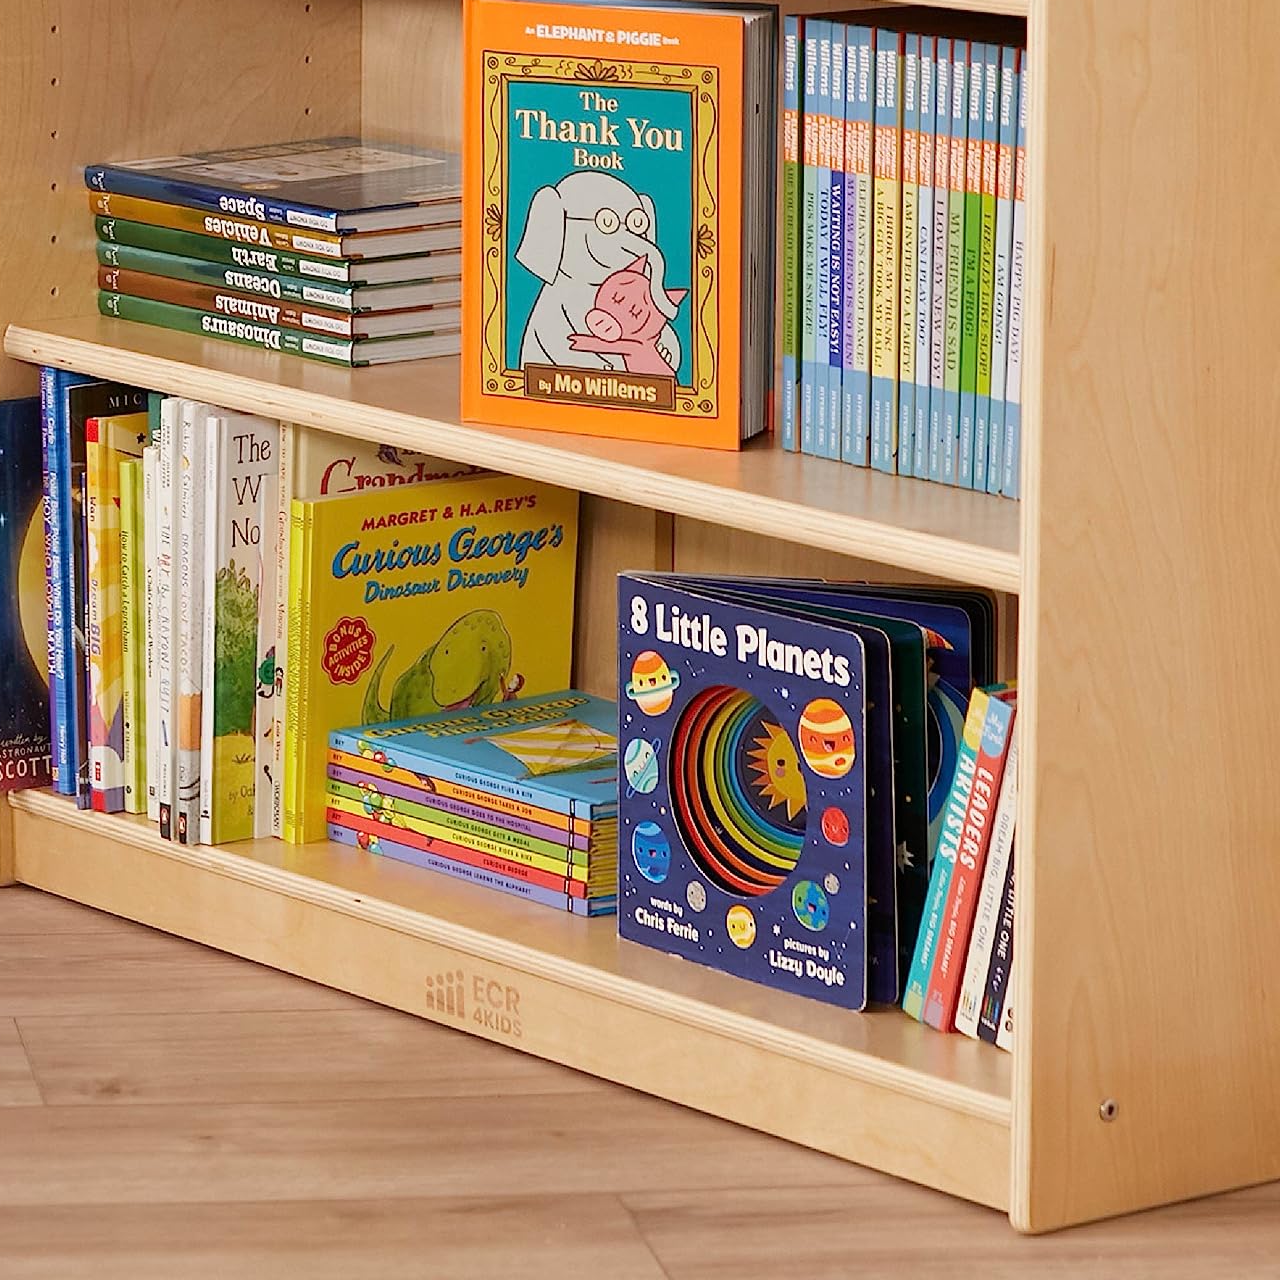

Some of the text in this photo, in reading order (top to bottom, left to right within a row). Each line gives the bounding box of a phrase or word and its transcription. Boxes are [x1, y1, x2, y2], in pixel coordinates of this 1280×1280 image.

[536, 24, 605, 43] ELEPHANT
[605, 32, 615, 43] &
[616, 30, 661, 46] PIGGIE
[784, 35, 796, 90] Willems
[820, 39, 830, 95] Willems
[846, 45, 856, 102] Willems
[877, 50, 887, 107] Willems
[905, 53, 916, 110] Willems
[937, 58, 948, 115] Willems
[970, 62, 982, 120] Willems
[1001, 67, 1013, 126] Willems
[579, 91, 619, 113] The
[515, 108, 683, 152] Thank You
[573, 147, 624, 171] Book
[219, 196, 267, 221] Space
[820, 188, 829, 242] TODAY
[204, 217, 272, 247] Vehicles
[935, 211, 944, 258] LOVE
[231, 247, 279, 272] Earth
[830, 184, 841, 354] WAITING IS NOT EASY!
[224, 271, 281, 298] Oceans
[819, 257, 829, 299] WILL
[947, 212, 961, 370] MY FRIEND IS SAD
[215, 294, 281, 324] Animals
[818, 303, 828, 338] FLY!
[201, 316, 281, 350] Dinosaurs
[538, 373, 657, 402] By Mo Willems
[233, 433, 272, 464] The
[49, 472, 57, 499] Polar
[361, 508, 438, 531] MARGRET
[442, 506, 453, 519] &
[51, 528, 59, 553] Polar
[120, 530, 129, 551] How
[332, 524, 564, 579] Curious George's
[121, 553, 129, 563] to
[181, 533, 189, 587] DRAGONS
[121, 565, 130, 590] Catch
[363, 567, 529, 604] Dinosaur Discovery
[53, 582, 62, 609] What
[90, 579, 101, 655] Dream BIG
[121, 599, 130, 652] Leprechaun
[54, 627, 63, 647] You
[328, 625, 362, 651] BONUS
[328, 636, 368, 667] ACTIVITIES
[630, 595, 851, 687] 8 Little Planets
[333, 650, 369, 677] INSIDE!
[939, 752, 977, 864] ARTISTS
[959, 767, 994, 870] LEADERS
[650, 896, 683, 918] words by
[634, 907, 699, 942] Chris Ferrie
[975, 925, 989, 952] ONE
[783, 937, 830, 961] pictures by
[996, 930, 1010, 961] ONE
[768, 949, 846, 987] Lizzy Doyle
[472, 975, 520, 1016] ECR
[472, 1007, 522, 1038] 4KIDS
